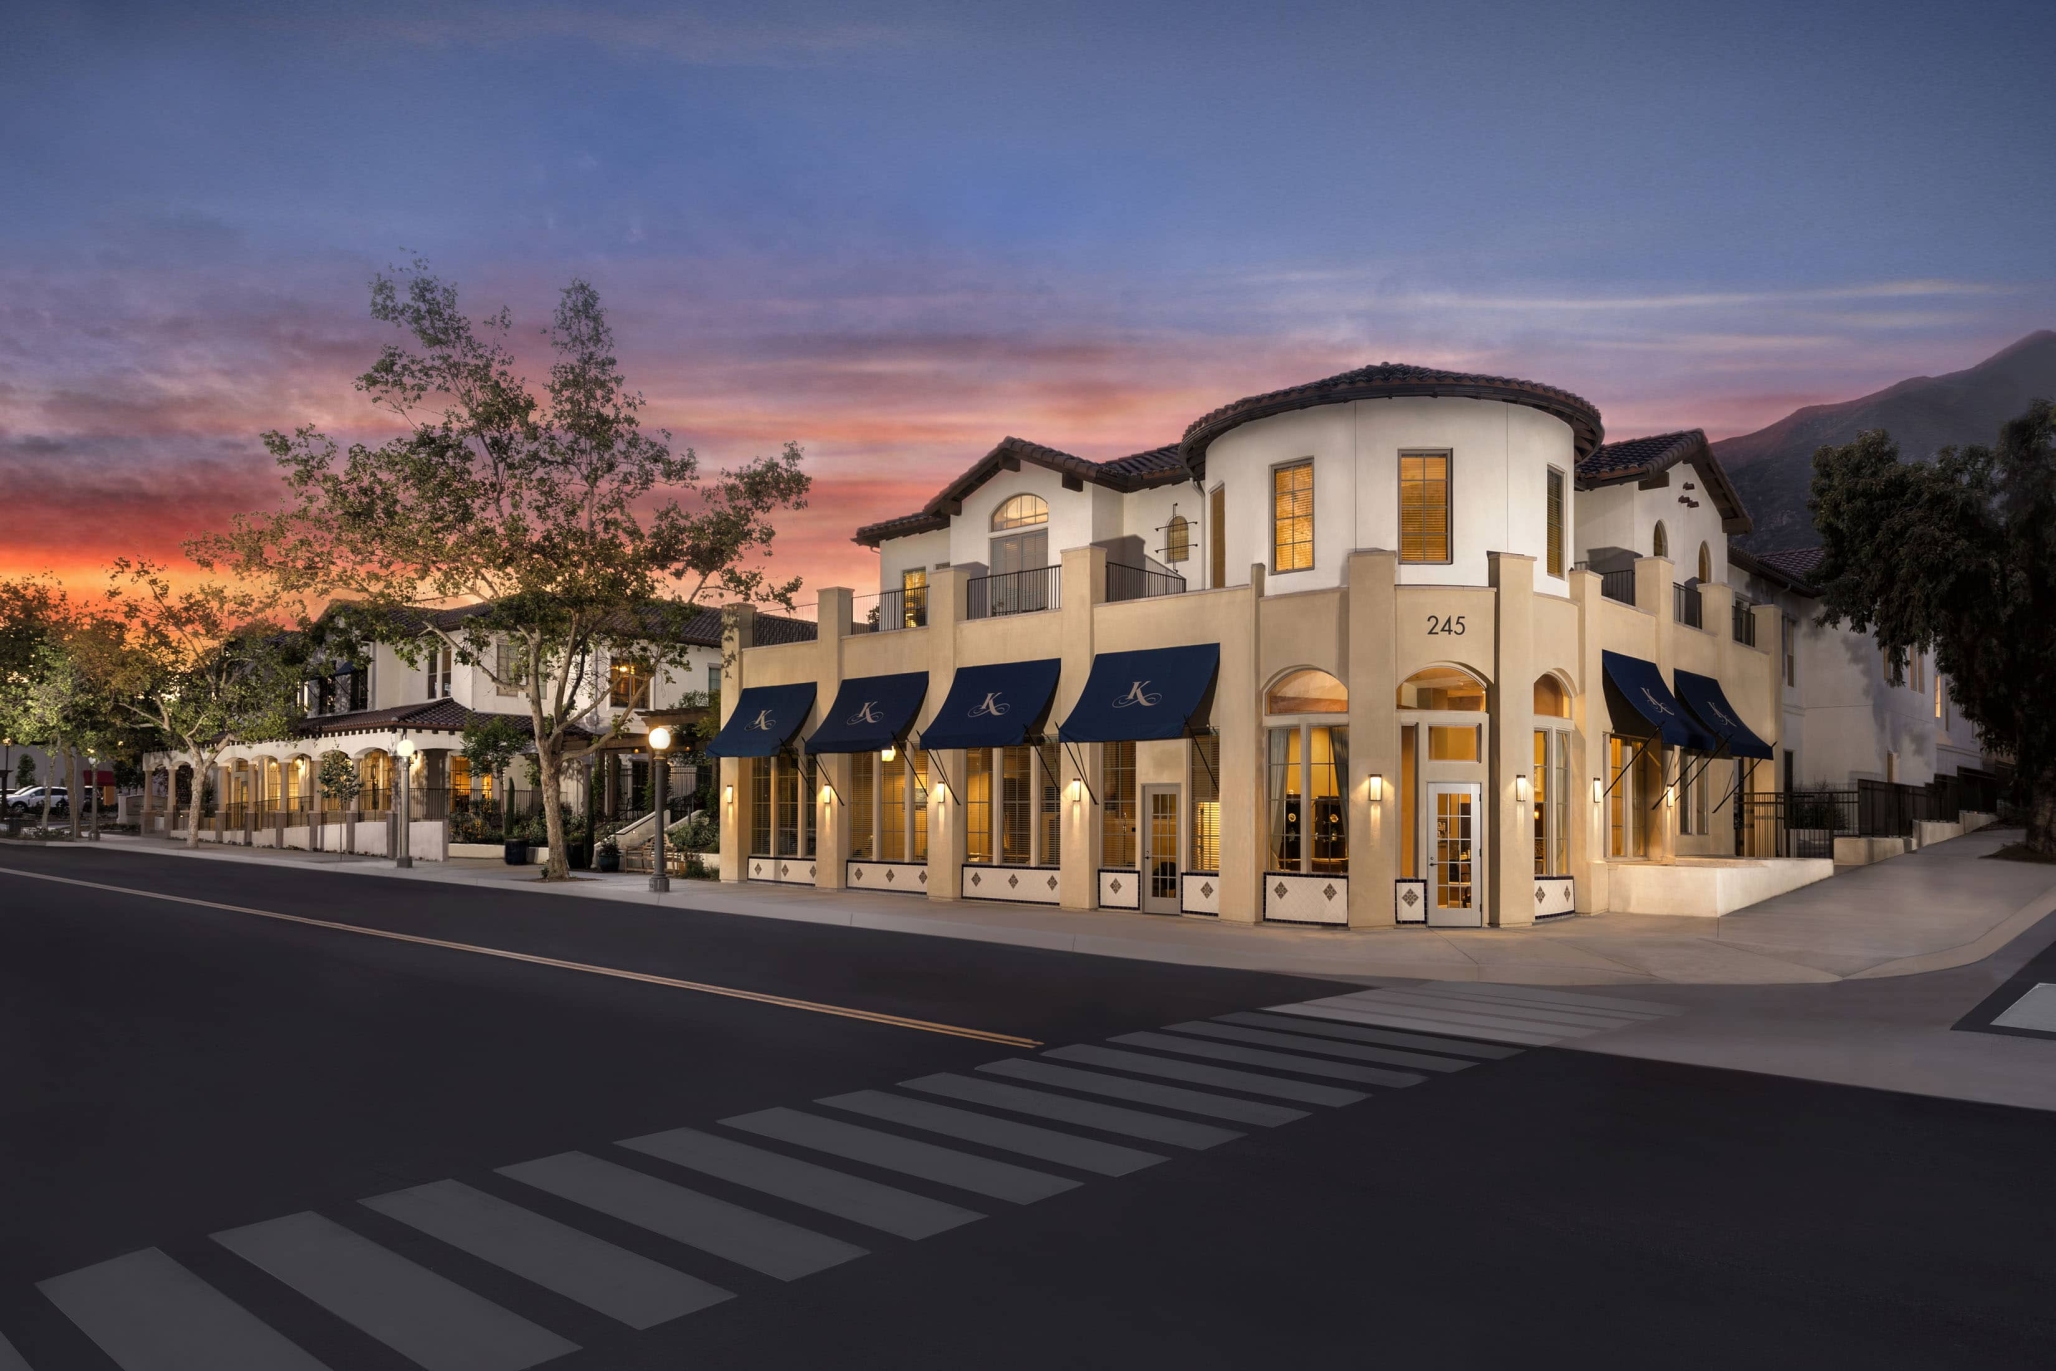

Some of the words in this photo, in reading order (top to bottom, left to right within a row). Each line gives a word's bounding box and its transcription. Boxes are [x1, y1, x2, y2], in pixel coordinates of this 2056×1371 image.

[1427, 615, 1466, 636] 245
[968, 692, 1010, 717] K
[1112, 680, 1162, 708] K
[744, 709, 776, 731] K
[847, 701, 884, 725] K
